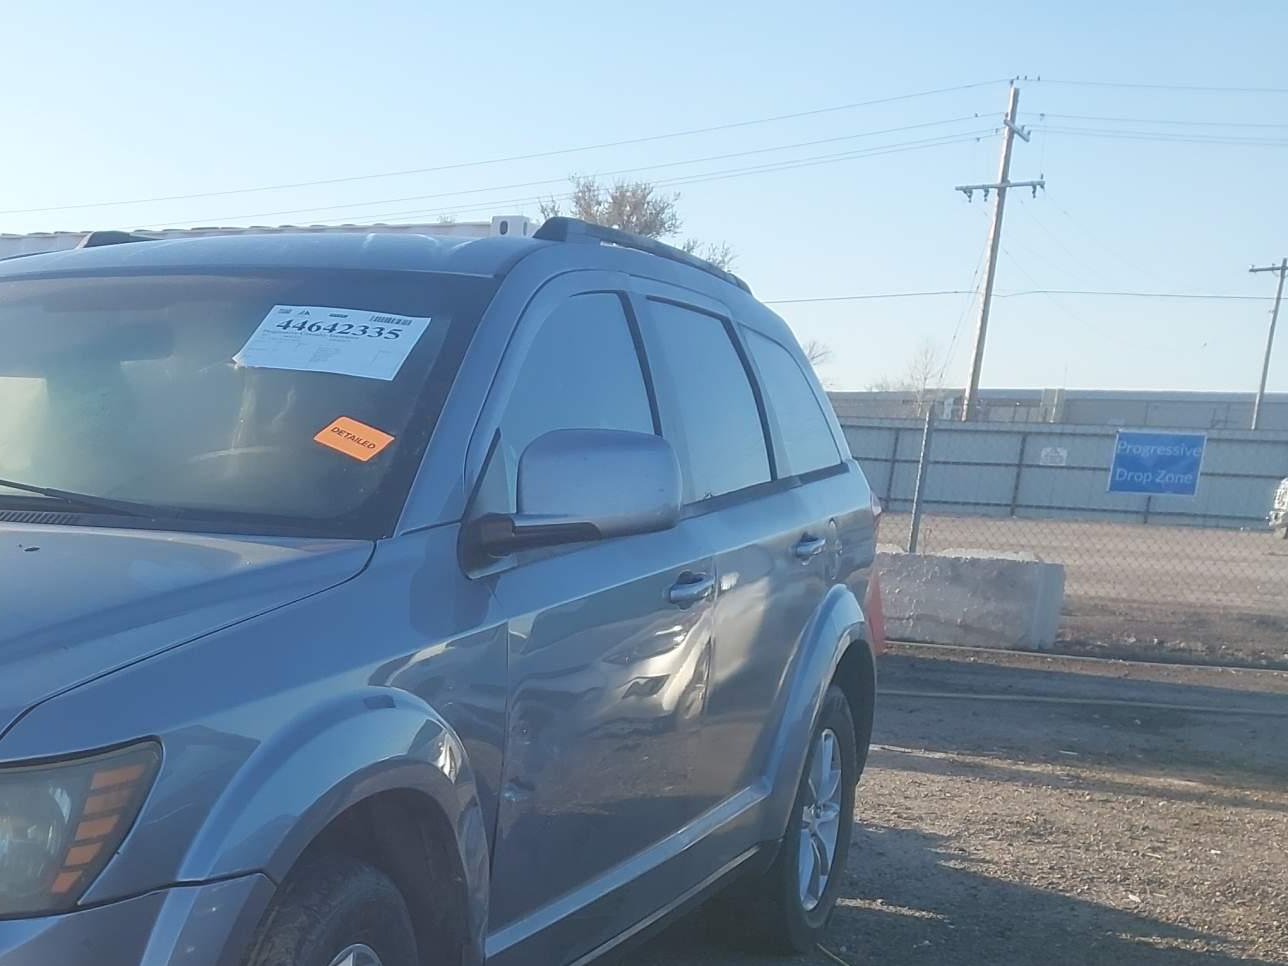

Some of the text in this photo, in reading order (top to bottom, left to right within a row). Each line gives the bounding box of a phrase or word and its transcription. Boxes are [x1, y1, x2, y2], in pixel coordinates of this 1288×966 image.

[276, 319, 403, 340] 44642335
[330, 426, 376, 450] DETAILED
[1117, 440, 1202, 457] Progressive
[1115, 468, 1193, 484] Drop Zone
